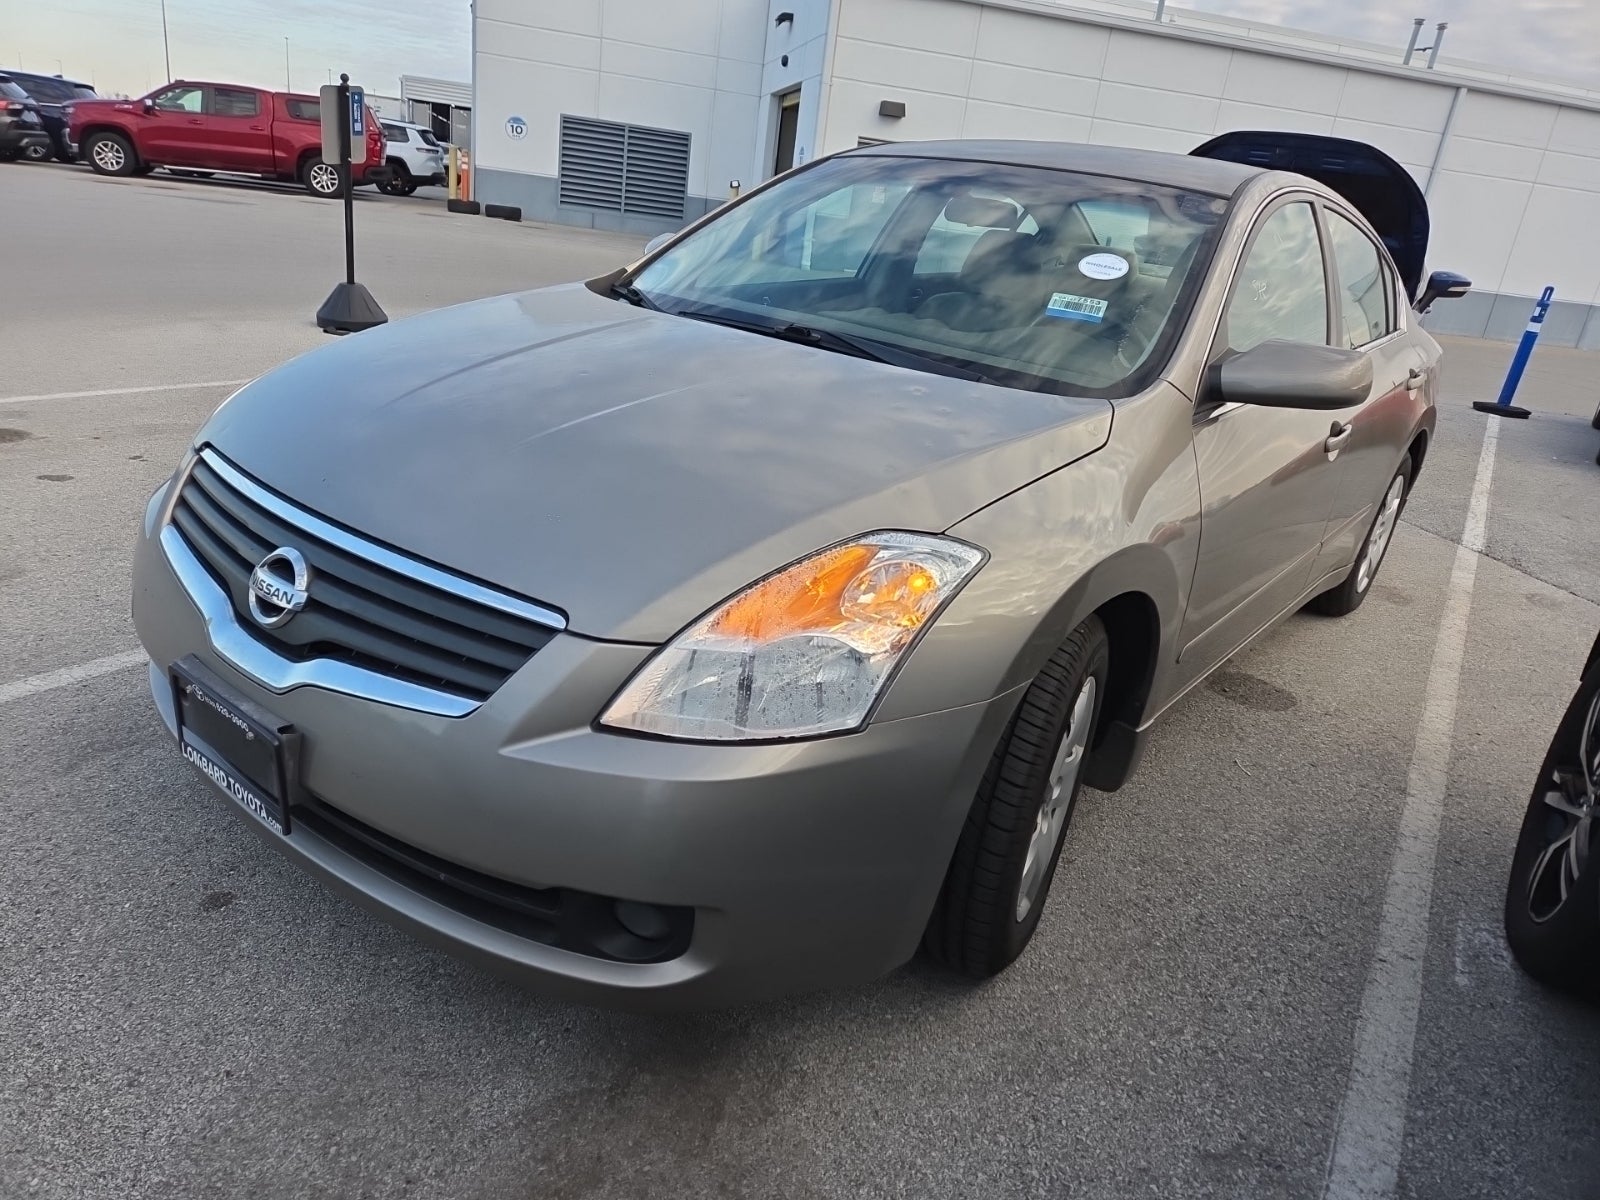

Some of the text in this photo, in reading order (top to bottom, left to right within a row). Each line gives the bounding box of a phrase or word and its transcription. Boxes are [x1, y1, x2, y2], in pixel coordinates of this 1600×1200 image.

[510, 124, 523, 135] 10
[1085, 260, 1123, 272] WHOLESALE
[252, 572, 294, 605] NISSAN
[181, 741, 227, 788] LOMBARD
